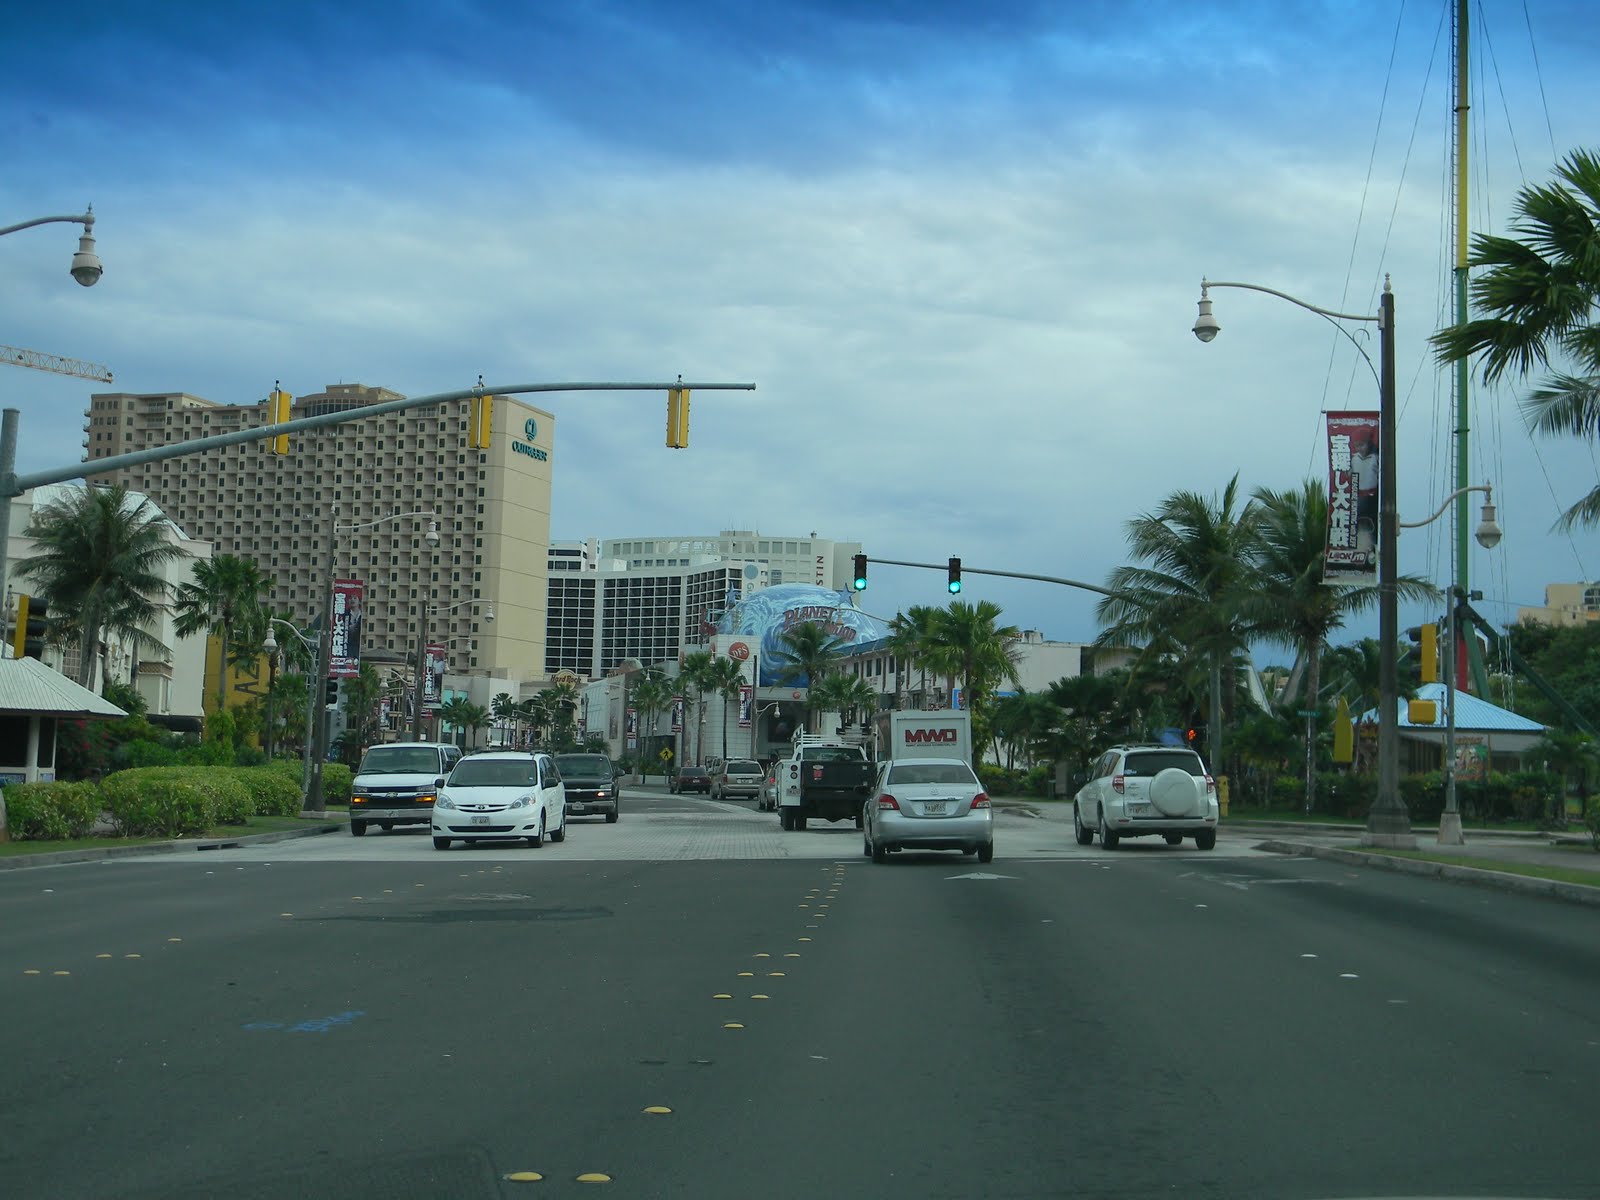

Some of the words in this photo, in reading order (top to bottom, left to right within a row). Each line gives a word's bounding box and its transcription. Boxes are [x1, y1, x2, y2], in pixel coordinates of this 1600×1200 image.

[512, 440, 548, 462] OUTRIGGER
[1329, 434, 1351, 547] 宝探し大作戦
[783, 605, 838, 624] PLANET
[551, 674, 567, 683] Hard
[567, 674, 581, 684] Rock
